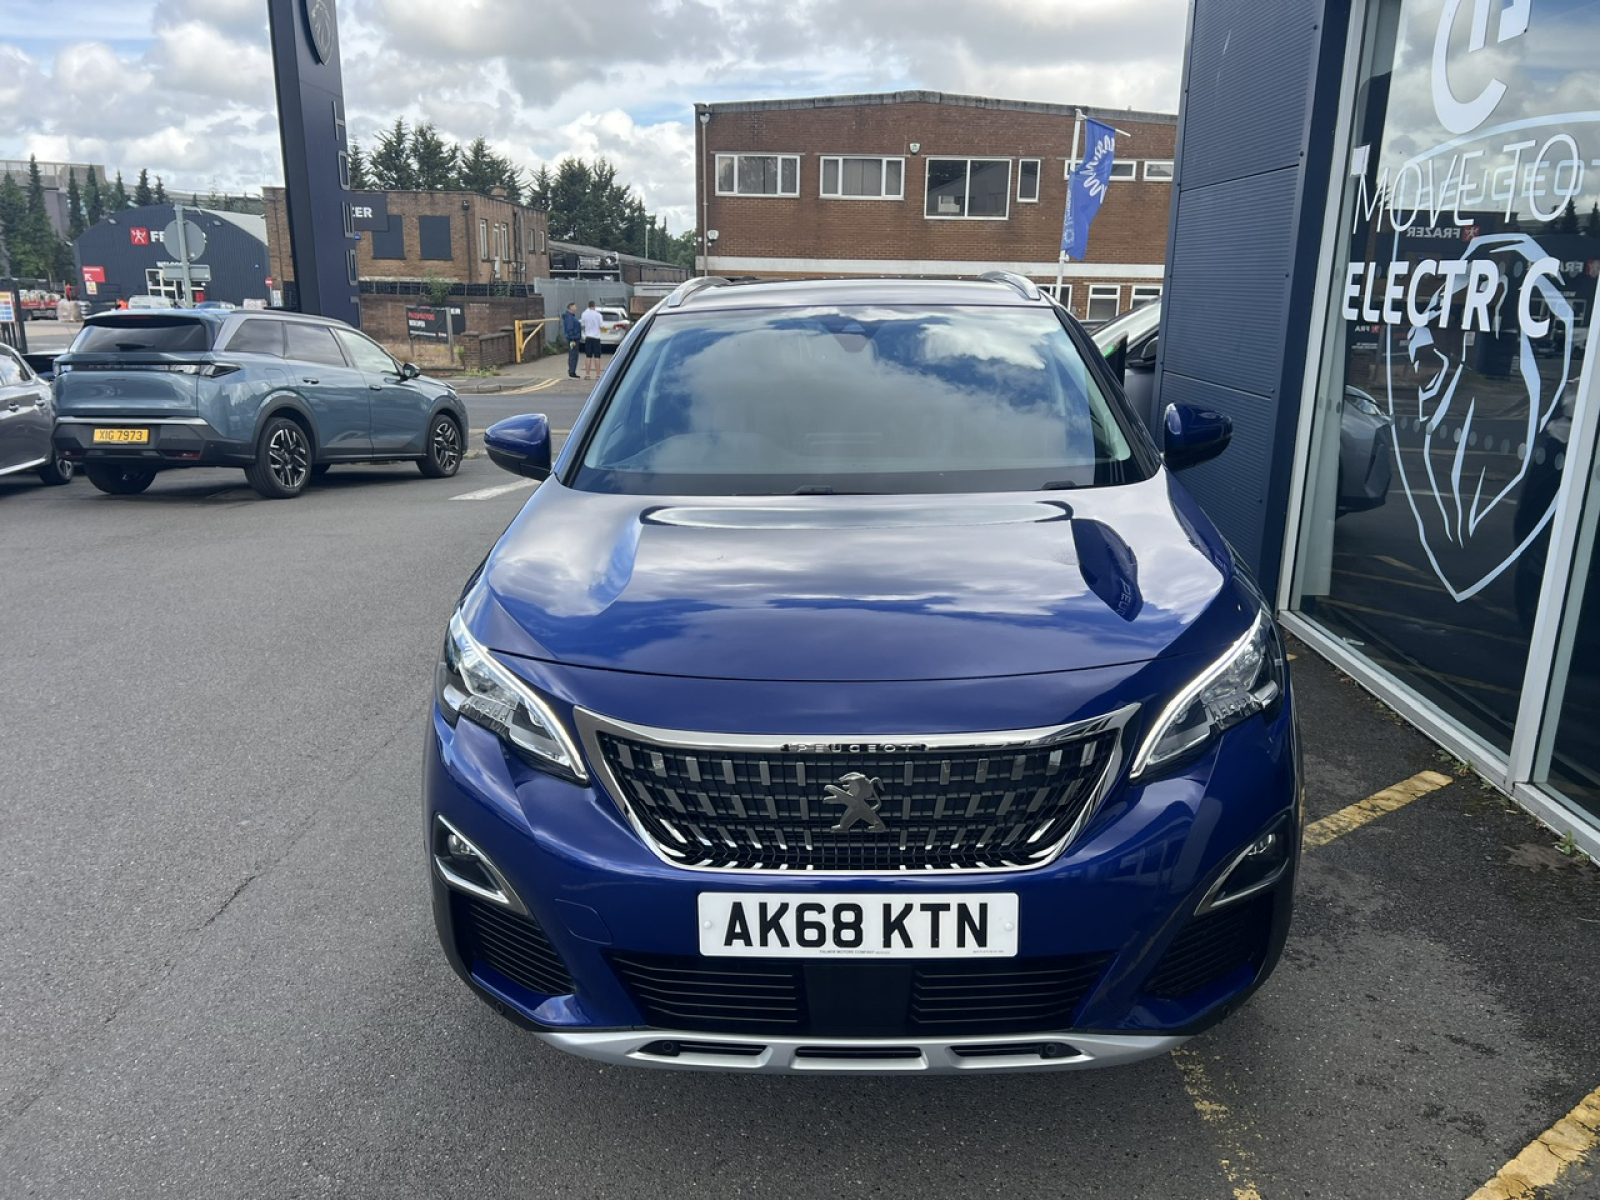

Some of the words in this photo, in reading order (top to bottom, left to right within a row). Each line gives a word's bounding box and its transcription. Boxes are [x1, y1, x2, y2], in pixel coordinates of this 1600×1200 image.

[1353, 150, 1485, 234] MOVE
[1503, 134, 1579, 222] TO
[1342, 256, 1561, 338] ELECTRC
[99, 430, 114, 441] XIG
[117, 430, 142, 441] 7973
[797, 743, 914, 753] PEUGEOT
[723, 901, 863, 948] AK68
[882, 903, 988, 948] KTN
